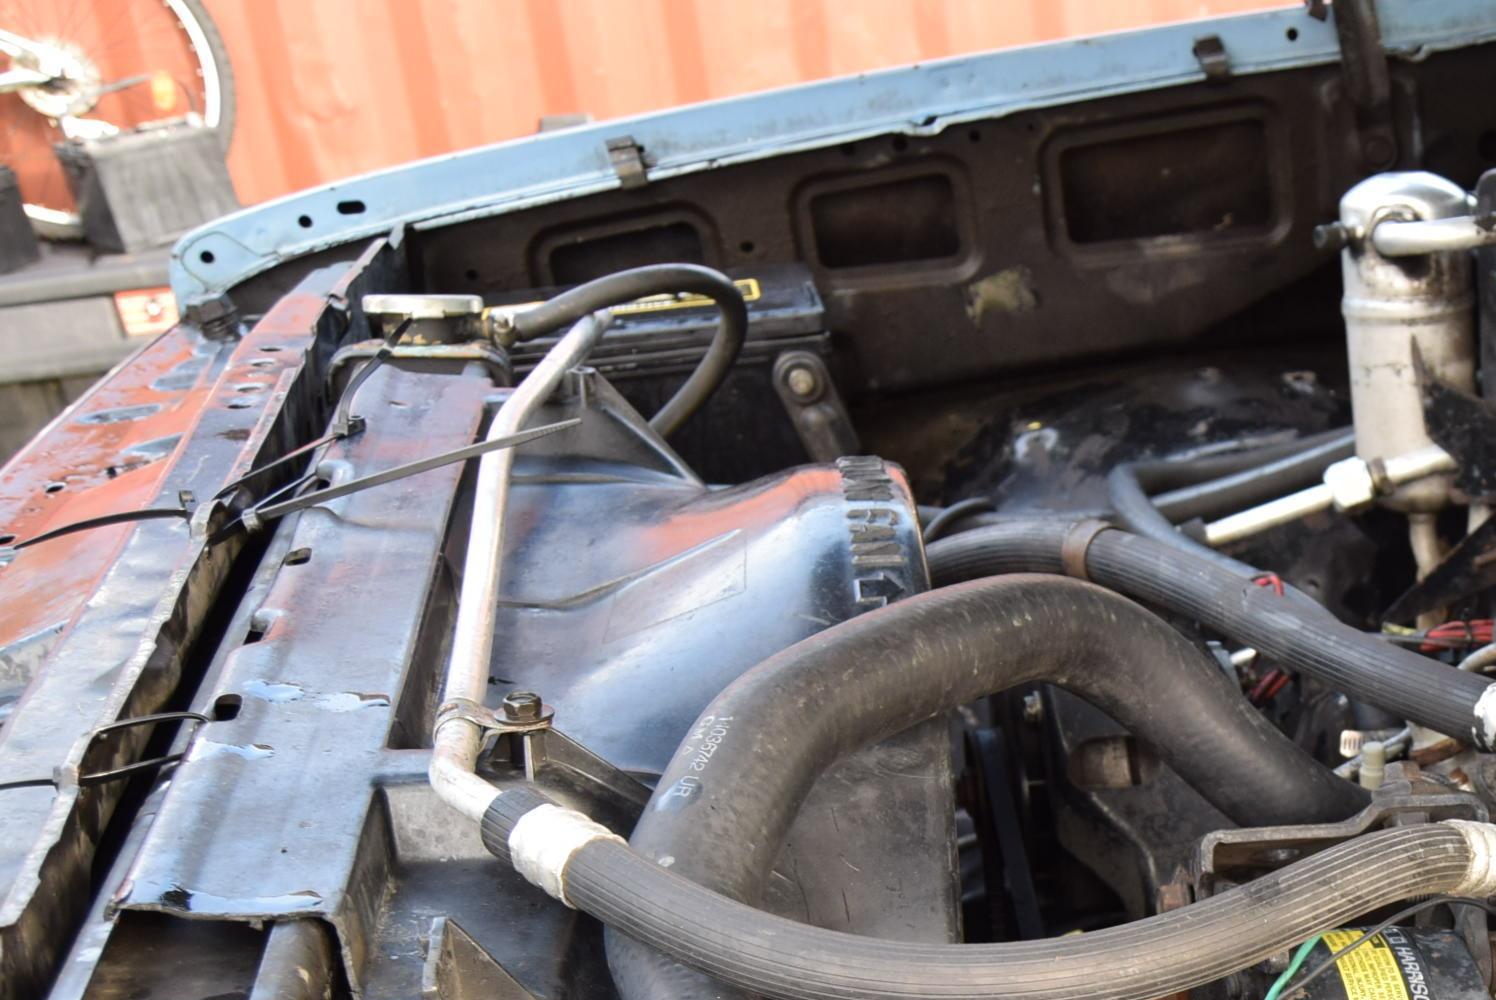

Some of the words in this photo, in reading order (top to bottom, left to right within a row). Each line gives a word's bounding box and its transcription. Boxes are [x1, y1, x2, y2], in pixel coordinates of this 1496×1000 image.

[672, 775, 700, 797] UR
[1345, 972, 1356, 996] SERVICE
[1365, 974, 1373, 986] MAY
